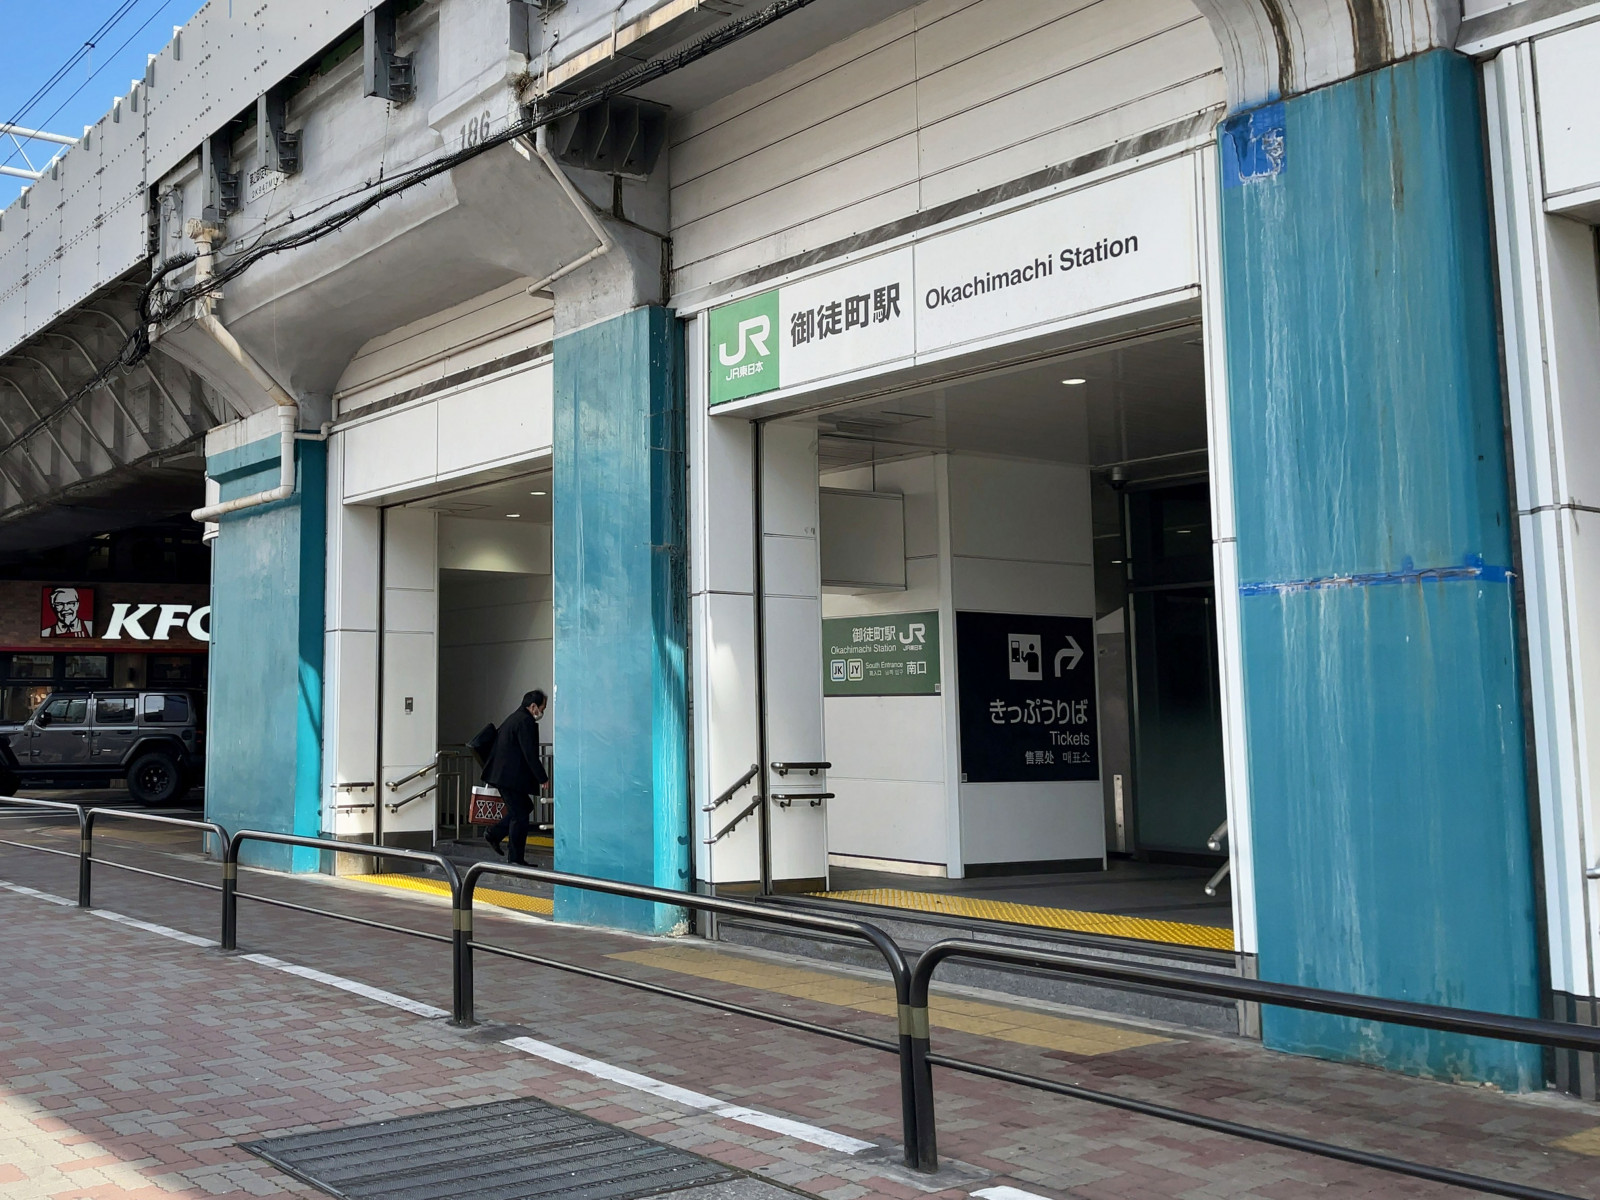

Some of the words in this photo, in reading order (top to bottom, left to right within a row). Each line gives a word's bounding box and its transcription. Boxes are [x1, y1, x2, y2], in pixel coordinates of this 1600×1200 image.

[459, 110, 491, 150] 186
[925, 254, 1053, 310] Okachimachi
[1059, 235, 1139, 272] Station
[790, 282, 901, 348] 御徒町駅
[719, 314, 771, 366] JR
[725, 361, 764, 381] JR東日本
[852, 625, 896, 643] 御徒町駅
[899, 623, 926, 644] JR
[830, 645, 872, 655] Okachimachi
[873, 643, 897, 653] Station
[833, 665, 843, 675] JK
[850, 664, 860, 675] JY
[865, 661, 880, 669] South
[906, 661, 927, 675] 南口
[989, 698, 1089, 725] きっぷうりば
[1049, 731, 1090, 746] Tickets
[1025, 750, 1055, 765] 售票处
[1062, 751, 1091, 764] 매표소
